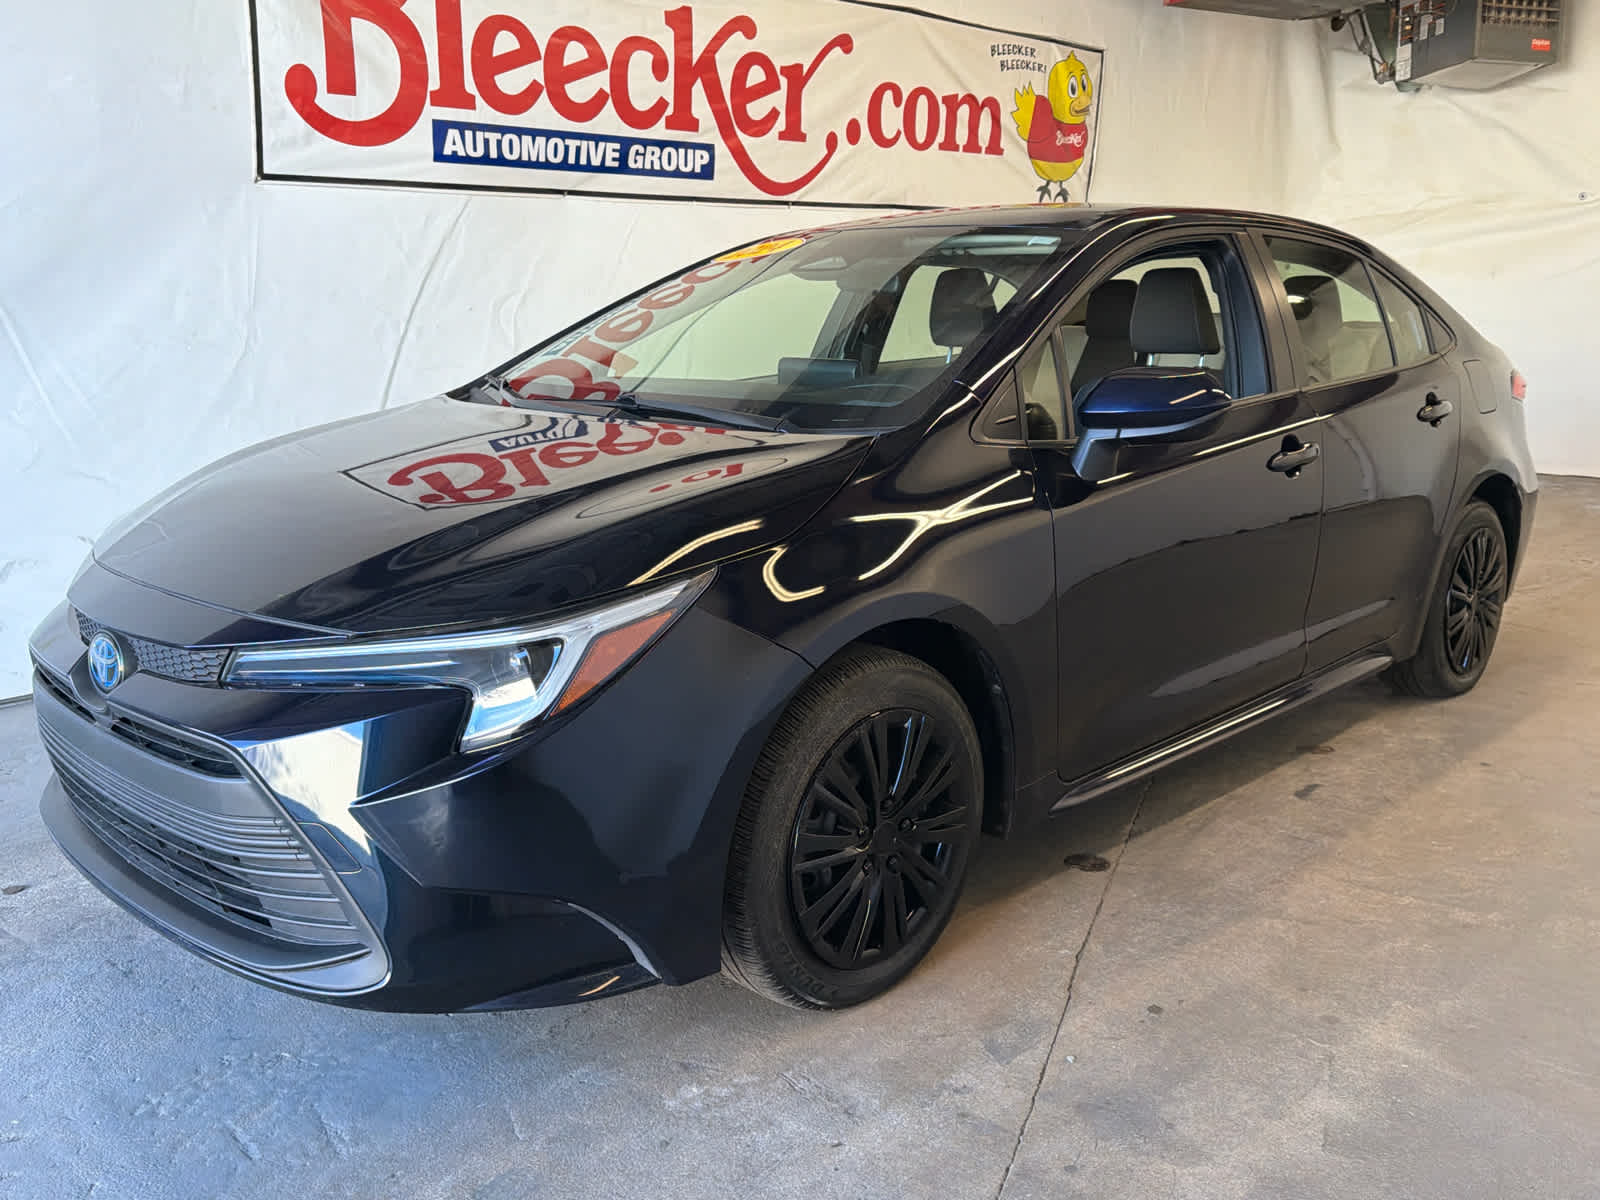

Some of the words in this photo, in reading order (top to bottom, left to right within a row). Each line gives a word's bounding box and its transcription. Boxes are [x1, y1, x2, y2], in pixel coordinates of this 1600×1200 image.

[990, 43, 1036, 58] BLEECKER
[443, 128, 620, 168] AUTOMOTIVE
[627, 143, 710, 173] GROUP
